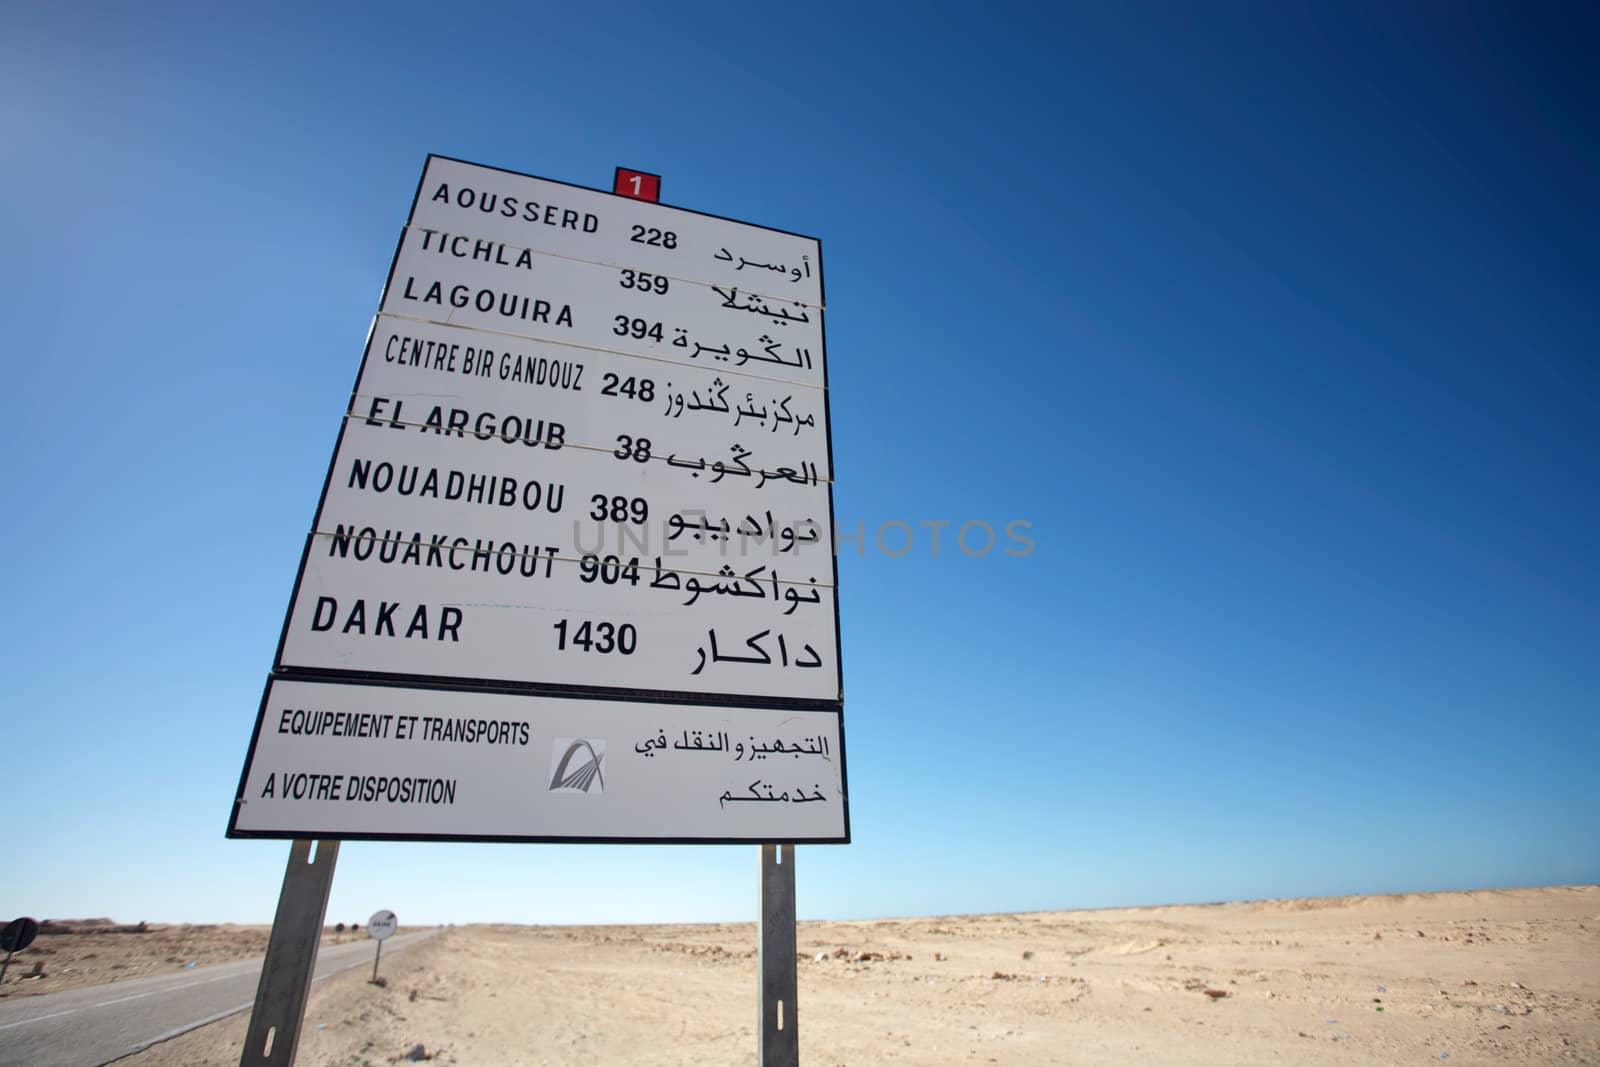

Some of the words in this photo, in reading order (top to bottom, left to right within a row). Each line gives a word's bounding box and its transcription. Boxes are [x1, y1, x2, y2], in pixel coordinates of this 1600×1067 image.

[630, 176, 641, 195] 1
[432, 184, 599, 234] AOUSSERD
[422, 229, 532, 269] TICHLA
[631, 225, 677, 249] 228
[620, 269, 668, 295] 359
[714, 248, 811, 283] أوسرد
[404, 277, 572, 327] LAGOUIRA
[712, 286, 809, 326] تيشلا
[613, 315, 663, 342] 394
[386, 335, 459, 372] CENTRE
[462, 347, 494, 377] BIR
[500, 353, 583, 390] GANDOUZ
[601, 373, 654, 402] 248
[365, 396, 408, 430] EL
[421, 406, 565, 450] ARGOUB
[772, 396, 814, 435] مركز
[614, 434, 652, 464] 38
[348, 459, 564, 513] NOUADHIBOU
[590, 494, 648, 524] 389
[328, 524, 560, 579] NOUAKCHOUT
[580, 554, 643, 586] 904
[650, 557, 820, 615] نواكشوط
[311, 596, 462, 641] DAKAR
[554, 619, 636, 655] 1430
[691, 629, 822, 674] داكار
[278, 710, 393, 738] EQUIPEMENT
[396, 716, 418, 739] ET
[423, 717, 529, 745] TRANSPORTS
[635, 729, 666, 757] في
[674, 731, 728, 752] النقل
[749, 736, 828, 760] التجهيز
[261, 773, 275, 798] A
[280, 773, 345, 801] VOTRE
[346, 776, 456, 804] DISPOSITION
[720, 780, 826, 807] خدمتكم
